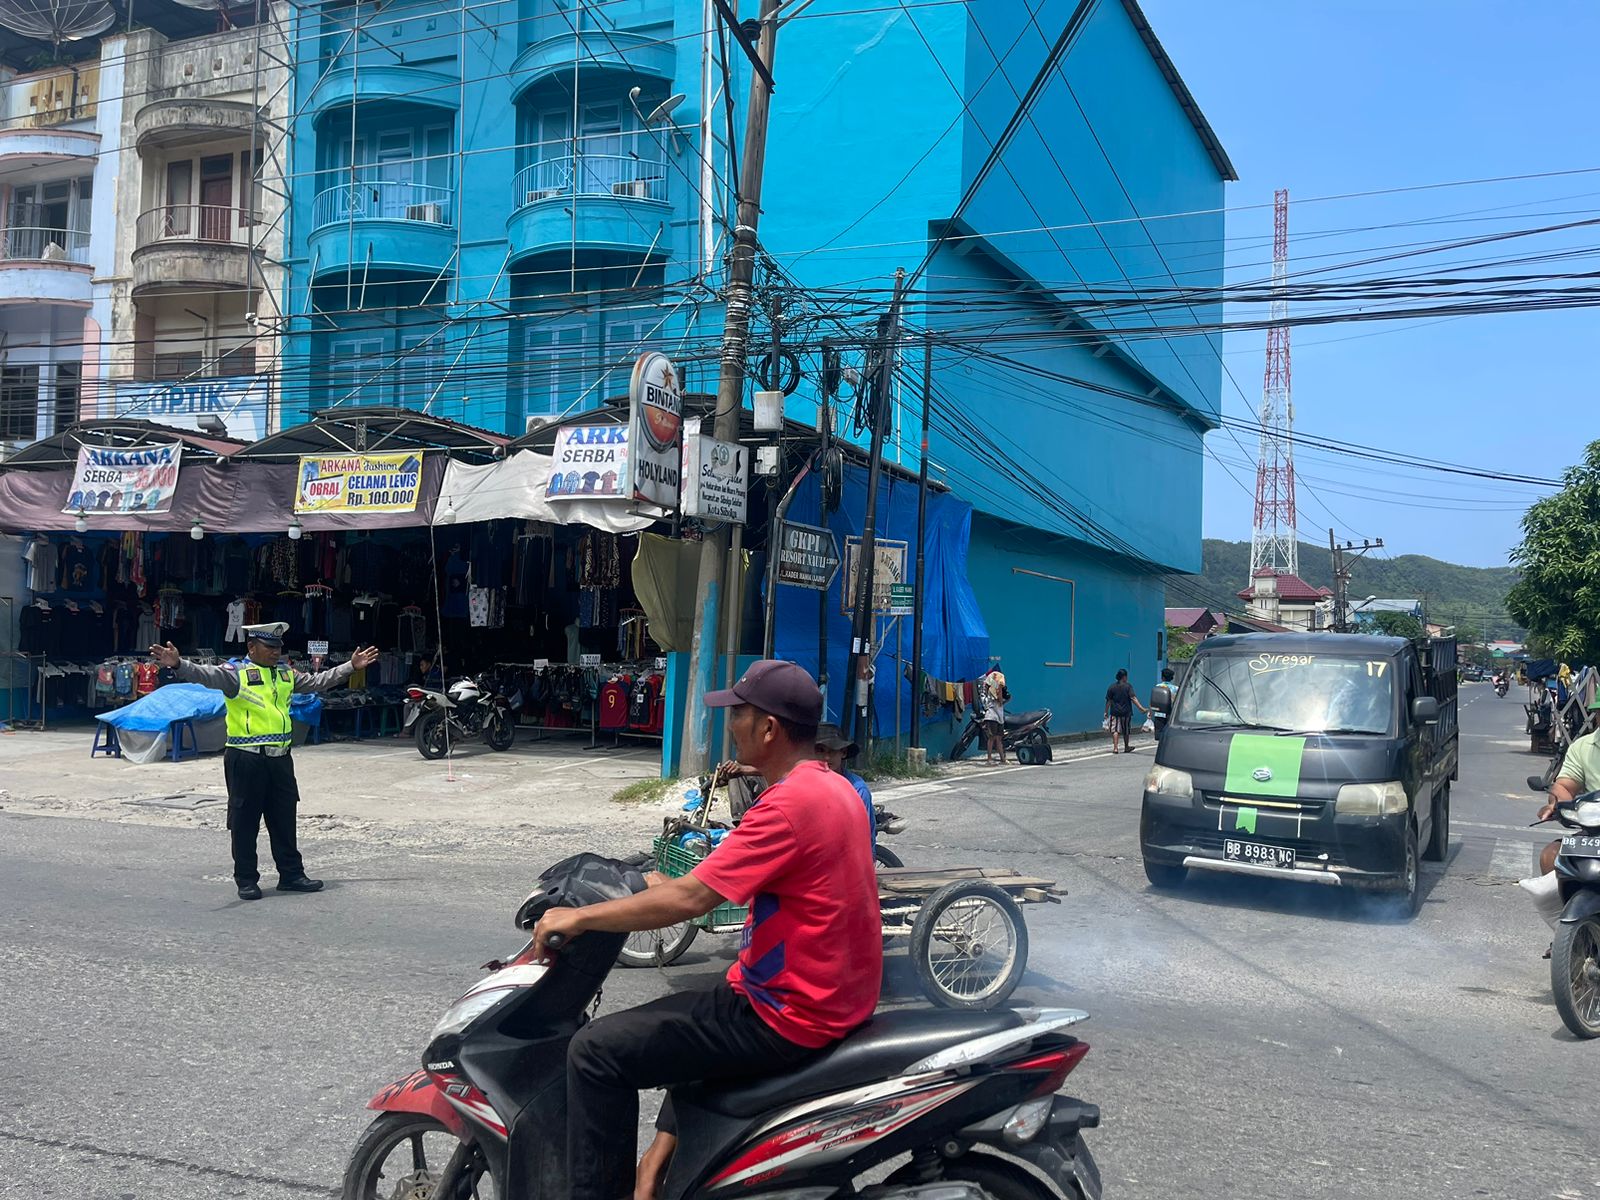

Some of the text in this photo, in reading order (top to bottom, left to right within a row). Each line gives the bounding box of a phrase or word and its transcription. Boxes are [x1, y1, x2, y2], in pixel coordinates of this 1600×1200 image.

[148, 383, 228, 413] OPTIK
[646, 386, 681, 414] BINTAN
[566, 427, 628, 445] ARK
[563, 449, 615, 463] SERBA
[320, 459, 361, 473] ARKANA
[638, 459, 677, 487] HOLYLAND
[83, 469, 122, 484] SERBA
[348, 473, 418, 490] CELANA LEVIS
[309, 482, 341, 497] OBRAL
[346, 490, 415, 506] Rp. 100.000
[789, 530, 821, 553] GKPI
[780, 549, 807, 565] RESORT
[807, 554, 826, 569] NAULI
[1249, 653, 1316, 676] Siregar
[1366, 661, 1388, 678] 17
[608, 694, 616, 708] 9
[1226, 841, 1241, 855] BB
[1244, 844, 1275, 860] 8983
[1278, 849, 1292, 863] NC
[427, 1061, 455, 1070] HONDA
